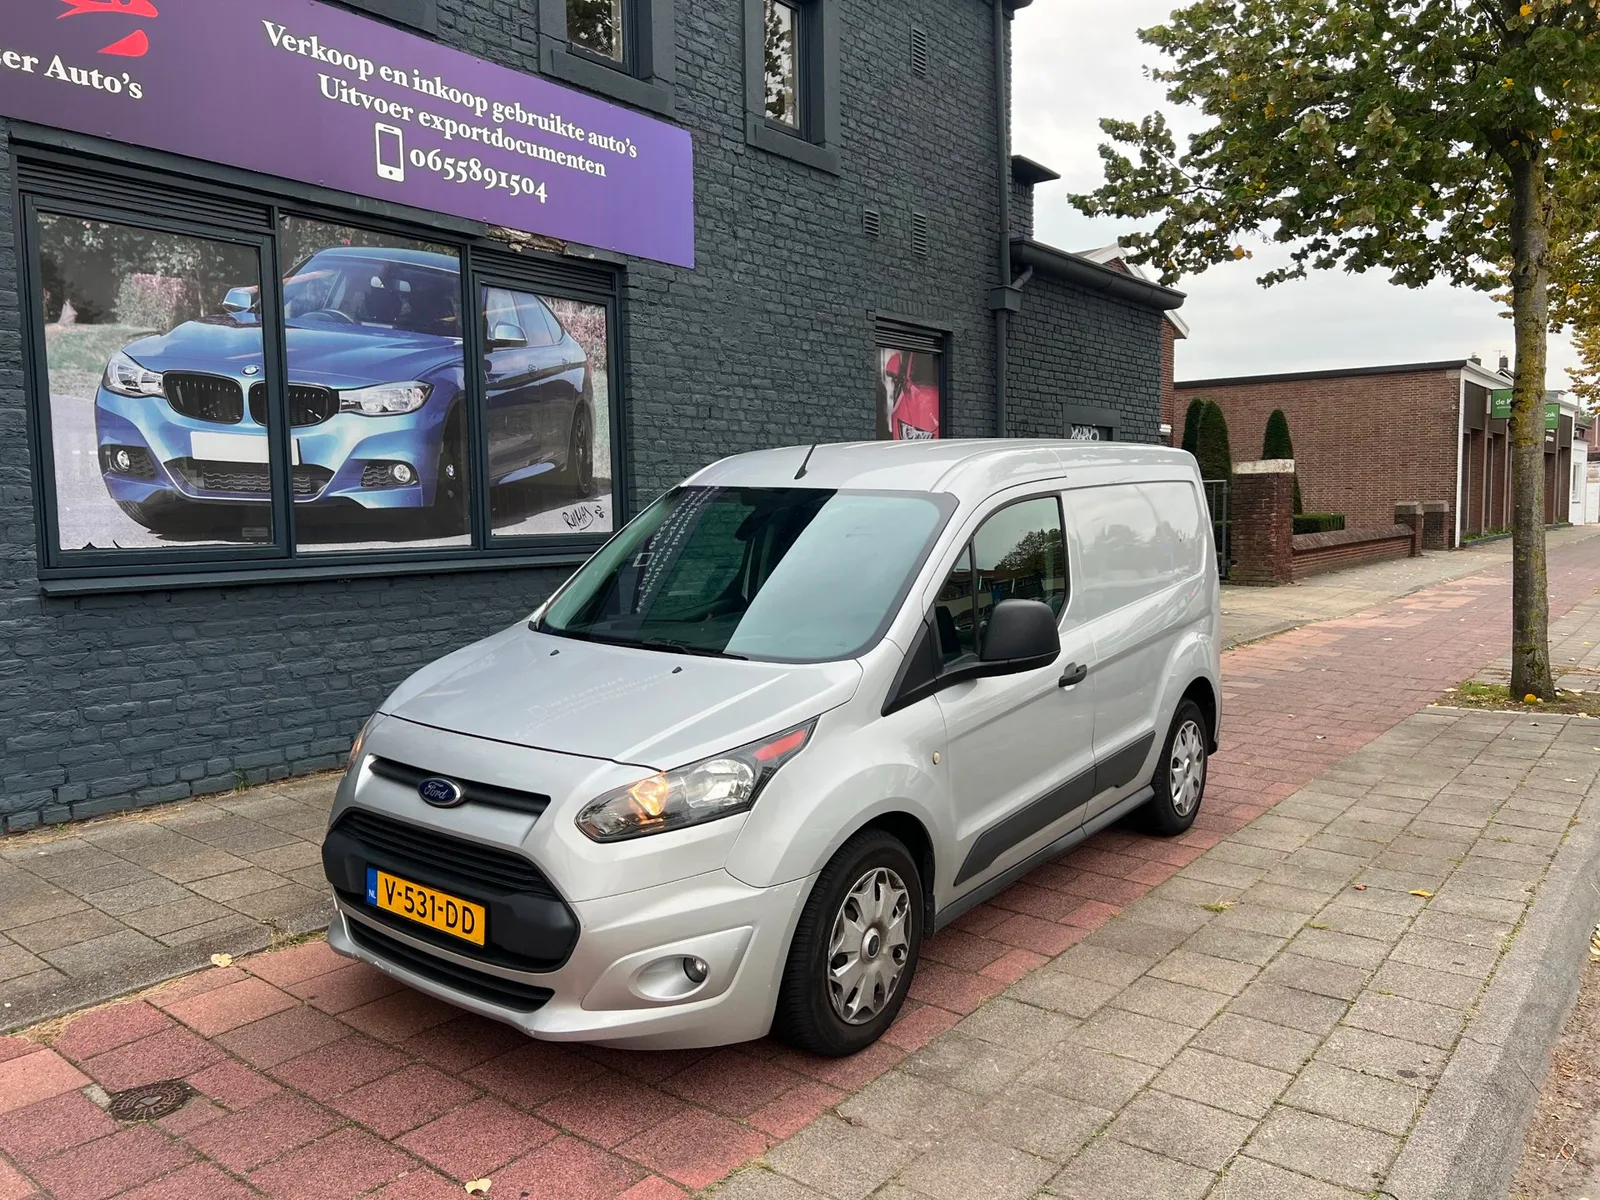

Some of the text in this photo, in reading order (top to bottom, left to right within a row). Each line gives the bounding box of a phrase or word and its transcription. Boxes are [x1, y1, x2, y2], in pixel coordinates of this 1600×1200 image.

[0, 48, 143, 99] er Auto's
[261, 19, 638, 158] Verkoop en inkoop gebruikte auto's
[317, 73, 607, 178] Uitvoer exportdocumenten
[409, 148, 548, 203] 0655891504
[423, 780, 449, 801] Ford
[368, 888, 377, 899] NL
[384, 878, 475, 934] V-531-DD
